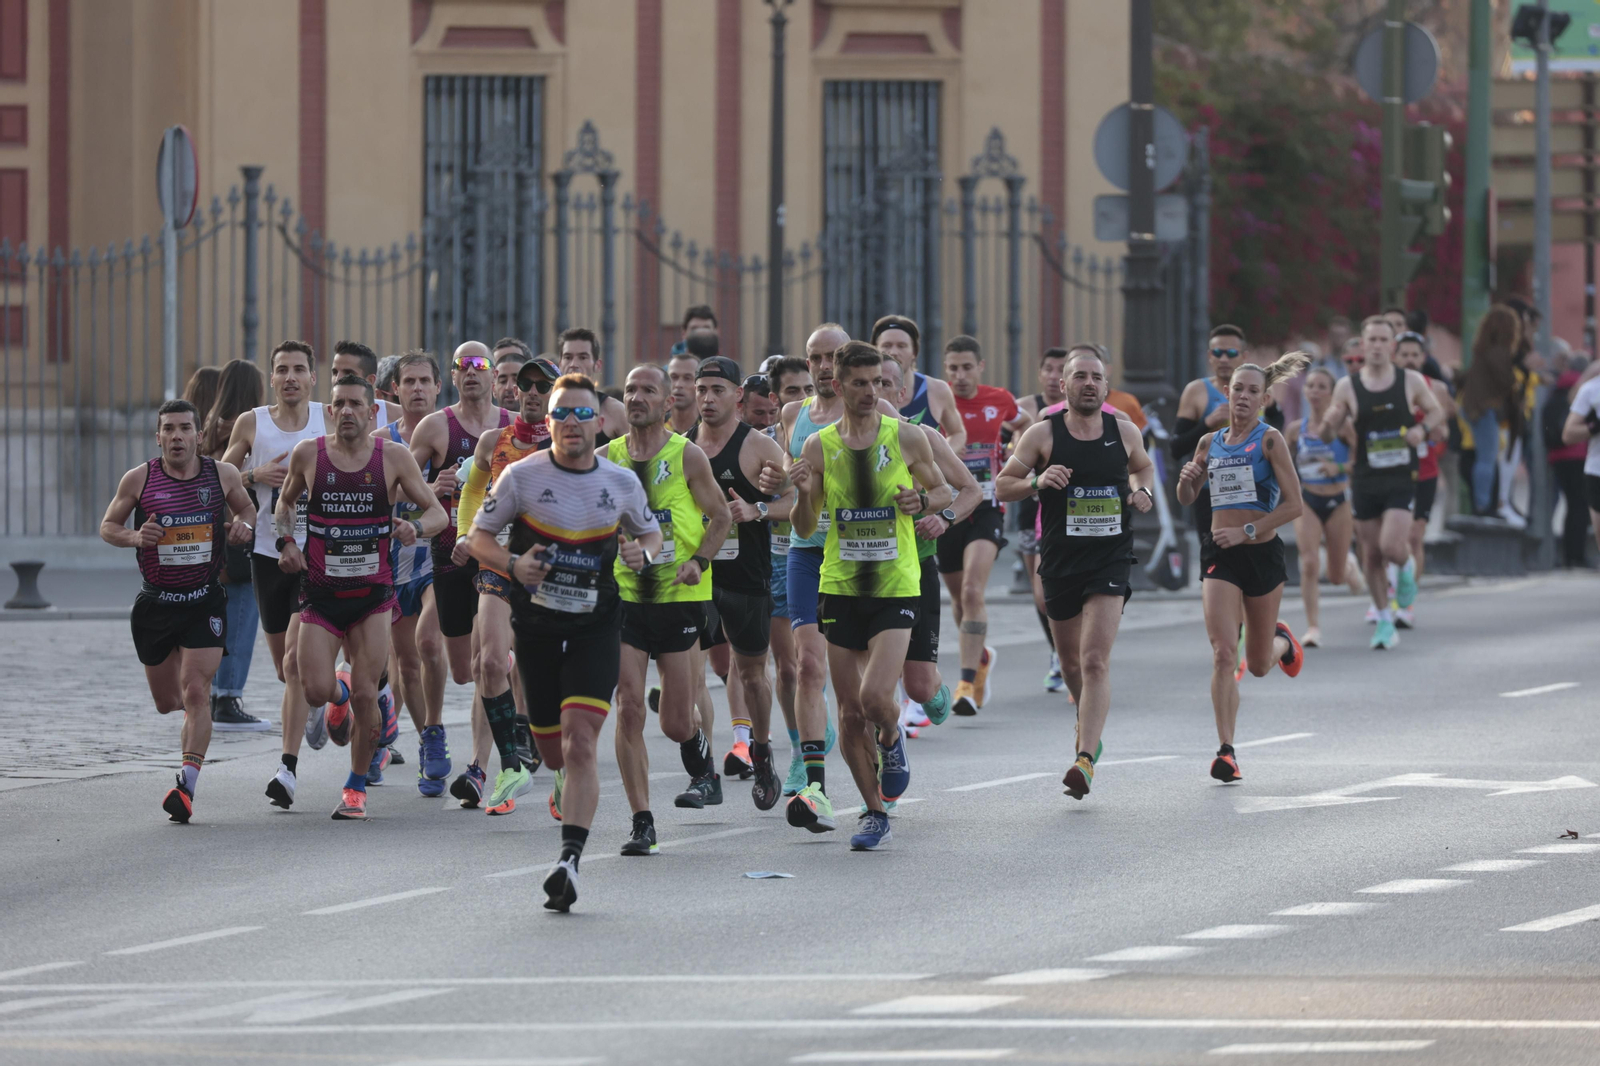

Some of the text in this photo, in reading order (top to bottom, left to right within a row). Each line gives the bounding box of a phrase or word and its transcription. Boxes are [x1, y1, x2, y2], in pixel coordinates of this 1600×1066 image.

[966, 460, 986, 468] URICH
[1220, 457, 1246, 466] ZURICH
[1221, 473, 1236, 481] F229
[322, 492, 373, 501] OCTAVUS
[321, 502, 373, 513] TRIATLÓN
[1087, 505, 1104, 513] 1261
[854, 509, 888, 519] ZURICH
[175, 515, 206, 525] ZURICH
[176, 532, 195, 541] 3861
[343, 528, 373, 536] ZURICH
[856, 528, 876, 537] 1576
[173, 545, 200, 553] PAULINO
[343, 544, 363, 553] 2989
[558, 554, 594, 567] ZURICH
[555, 572, 577, 584] 2591
[188, 585, 209, 600] MAX
[541, 584, 588, 599] PEPE VALERO
